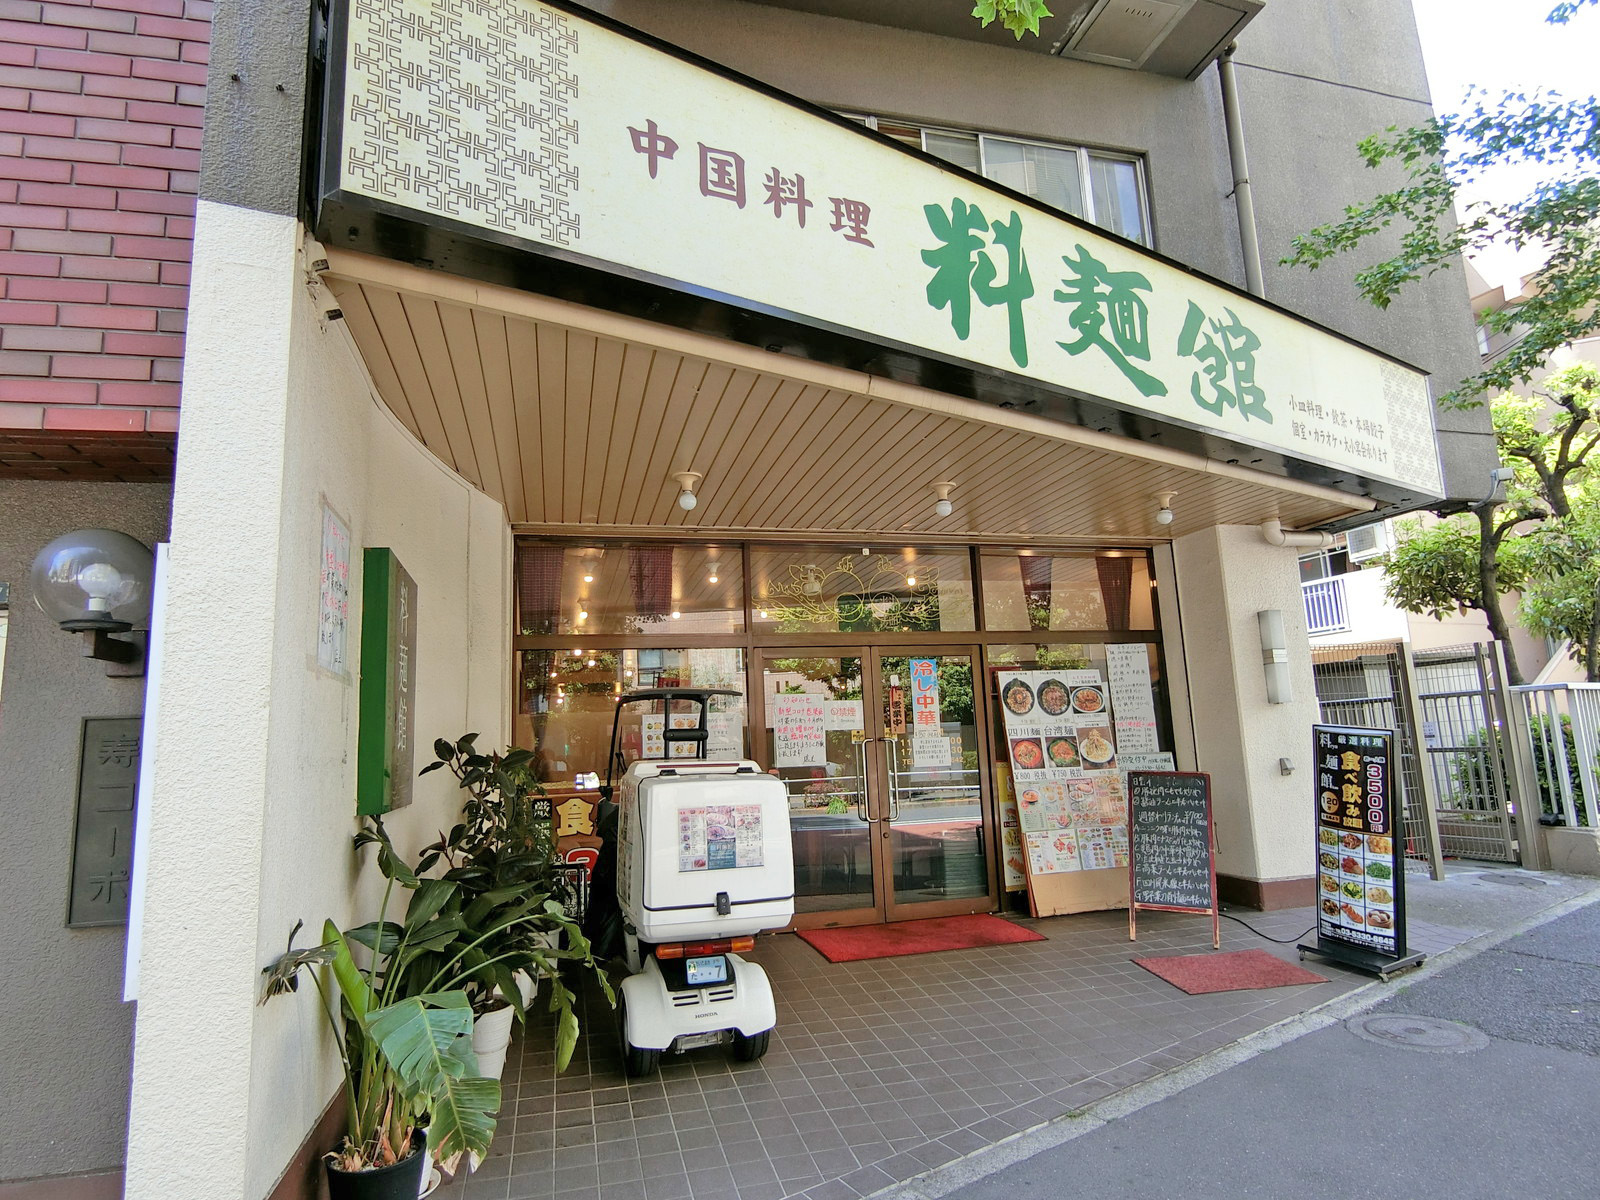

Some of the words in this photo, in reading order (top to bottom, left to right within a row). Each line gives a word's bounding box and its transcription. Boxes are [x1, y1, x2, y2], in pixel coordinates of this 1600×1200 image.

[626, 118, 875, 248] 中国料理
[913, 661, 936, 725] 冷し中華
[837, 707, 856, 717] 禁煙
[1338, 735, 1384, 747] 厳選料理
[695, 1011, 718, 1019] HONDA
